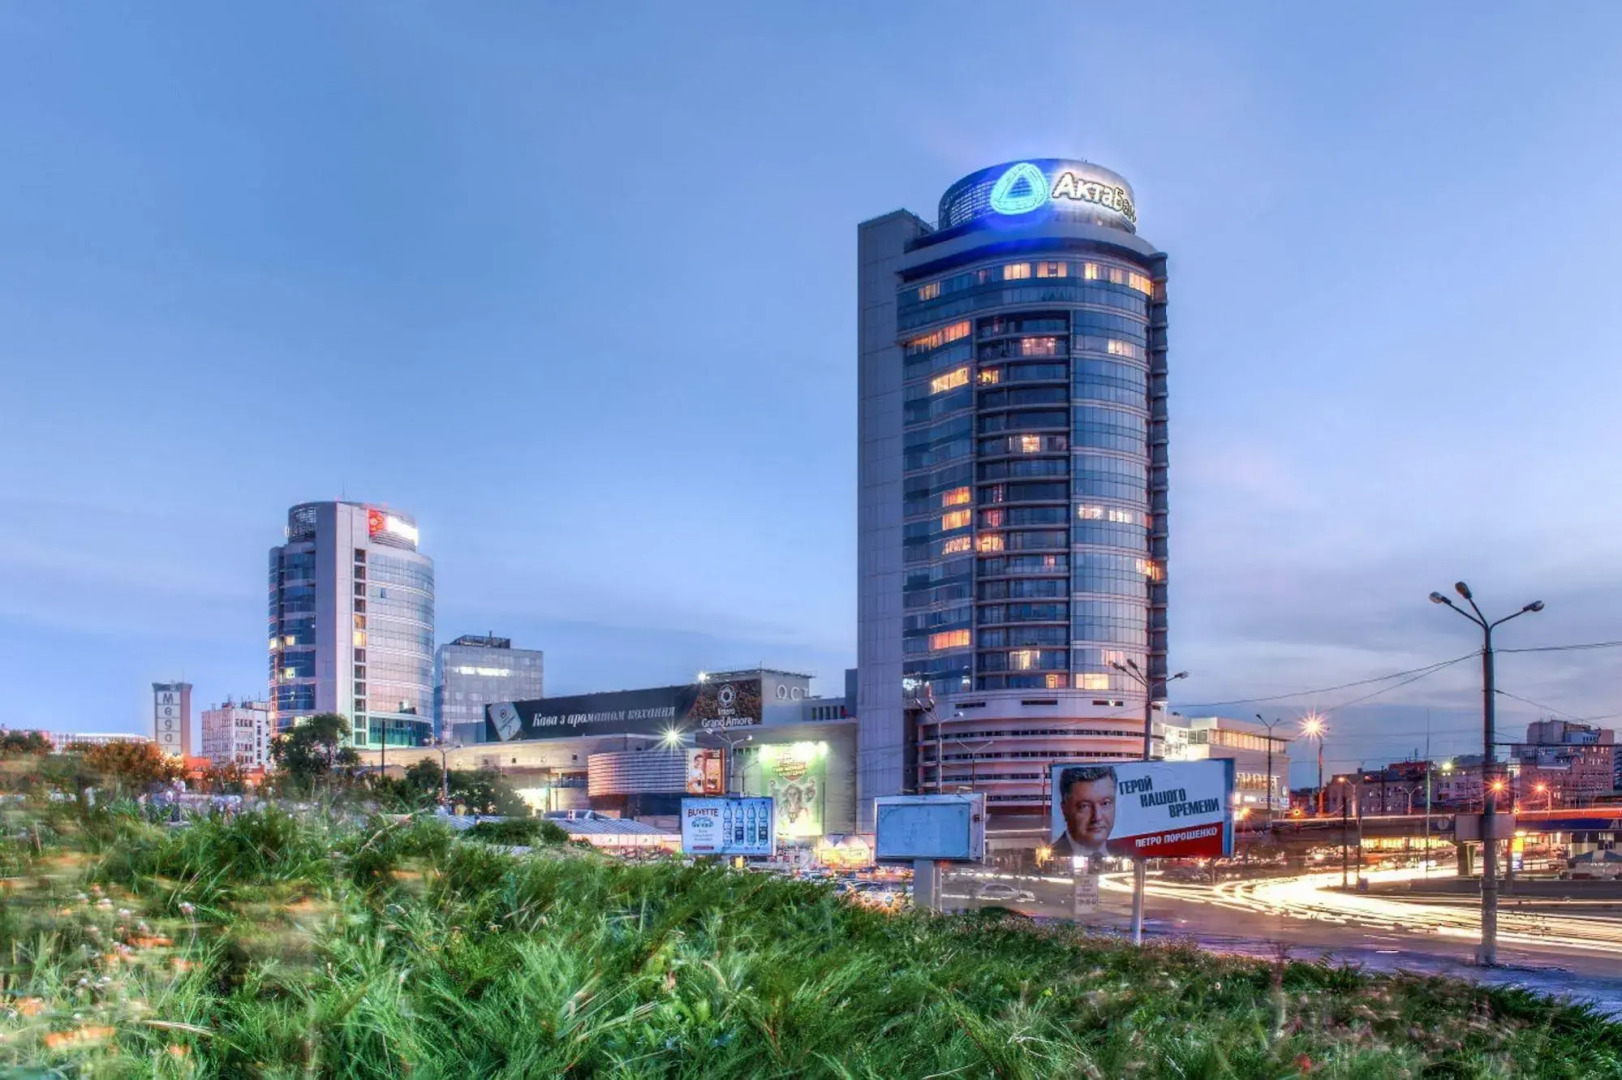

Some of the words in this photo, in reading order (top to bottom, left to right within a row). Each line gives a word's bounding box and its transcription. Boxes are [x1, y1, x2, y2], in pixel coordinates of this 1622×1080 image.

[532, 713, 557, 727] Кава
[559, 715, 566, 726] з
[567, 711, 625, 728] ароматом
[628, 706, 675, 720] кохання
[701, 716, 725, 728] Grand
[725, 716, 753, 726] Amore
[1119, 775, 1153, 795] ГЕРОЙ
[1140, 788, 1187, 808] НАШОГО
[1168, 798, 1220, 818] ВРЕМЕНИ
[688, 808, 719, 817] BUVETTE
[1135, 836, 1162, 847] ПЕТРО
[1164, 827, 1217, 844] ПОРОШЕНКО
